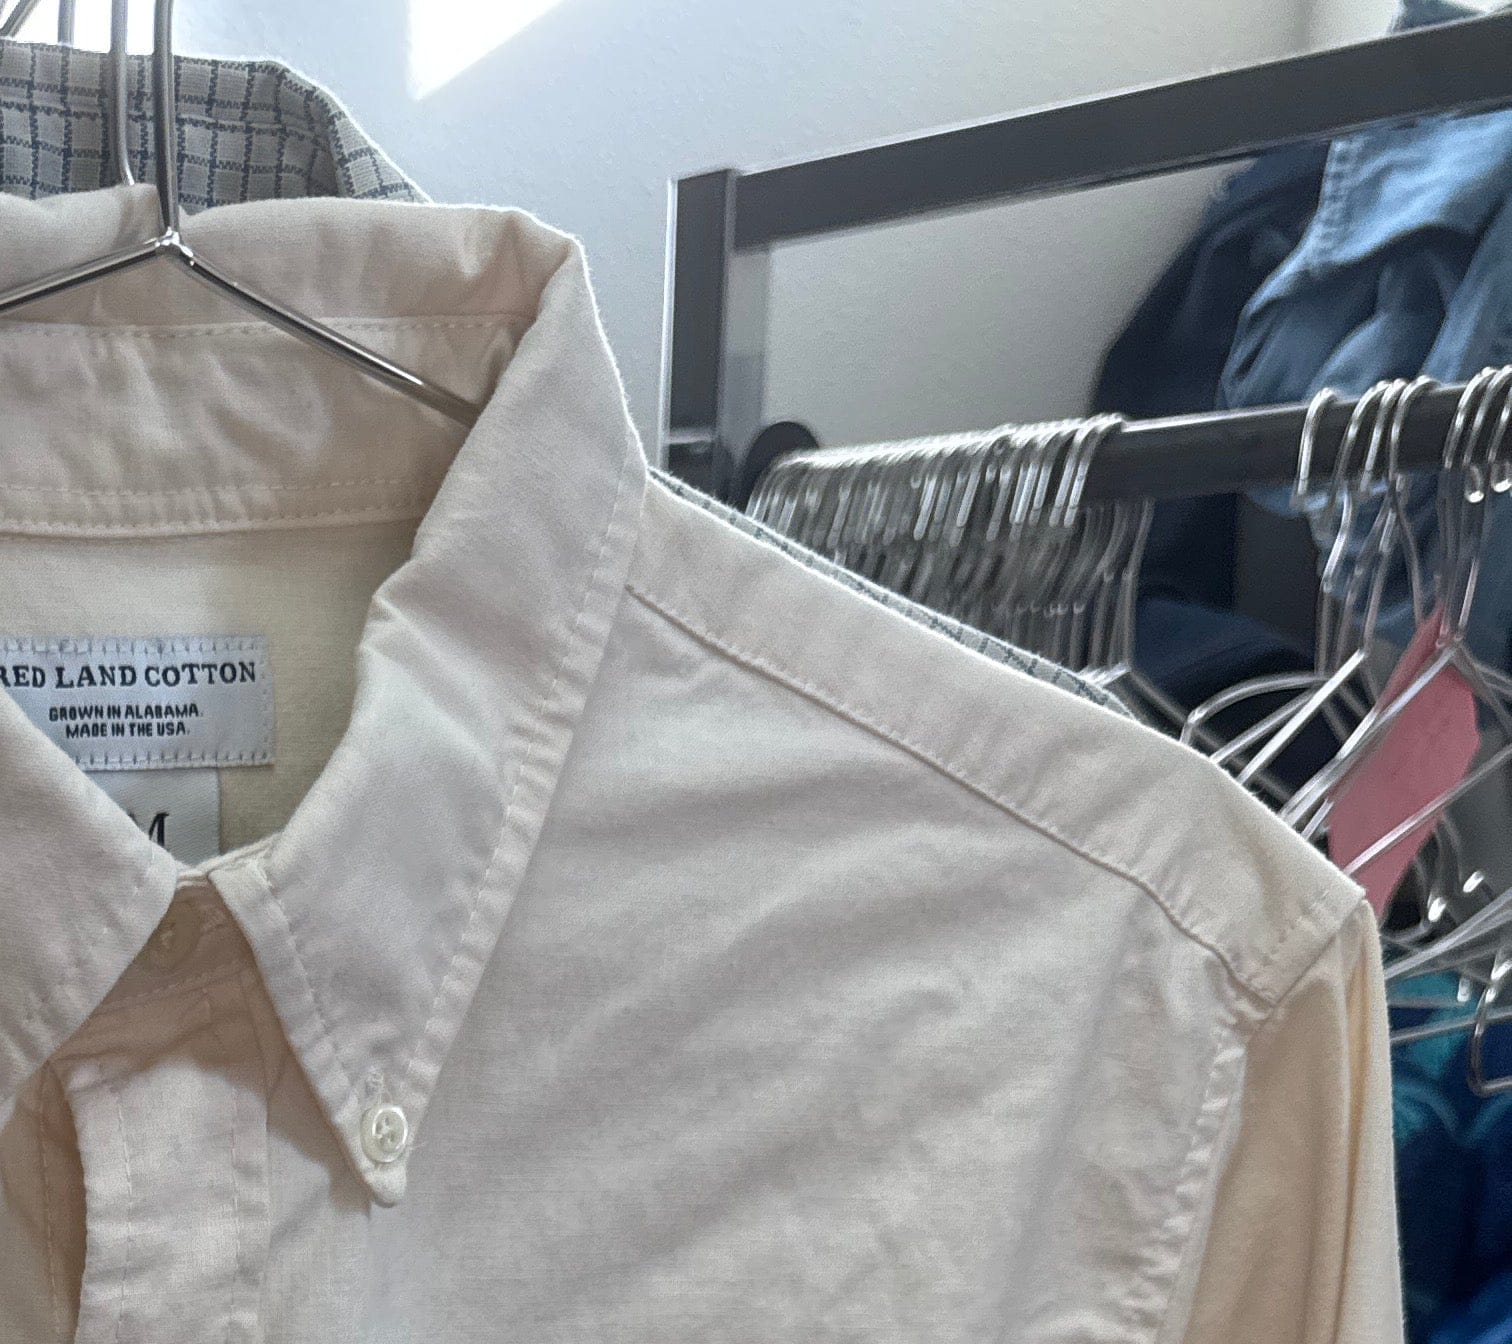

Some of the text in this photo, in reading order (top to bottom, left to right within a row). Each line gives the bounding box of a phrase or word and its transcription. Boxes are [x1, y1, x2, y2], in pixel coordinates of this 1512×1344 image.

[55, 665, 137, 688] LAND
[144, 662, 256, 687] COTTON
[49, 706, 104, 722] GROWN
[106, 706, 122, 720] IN
[65, 725, 107, 739] MADE
[111, 724, 126, 738] IN
[129, 724, 153, 738] THE
